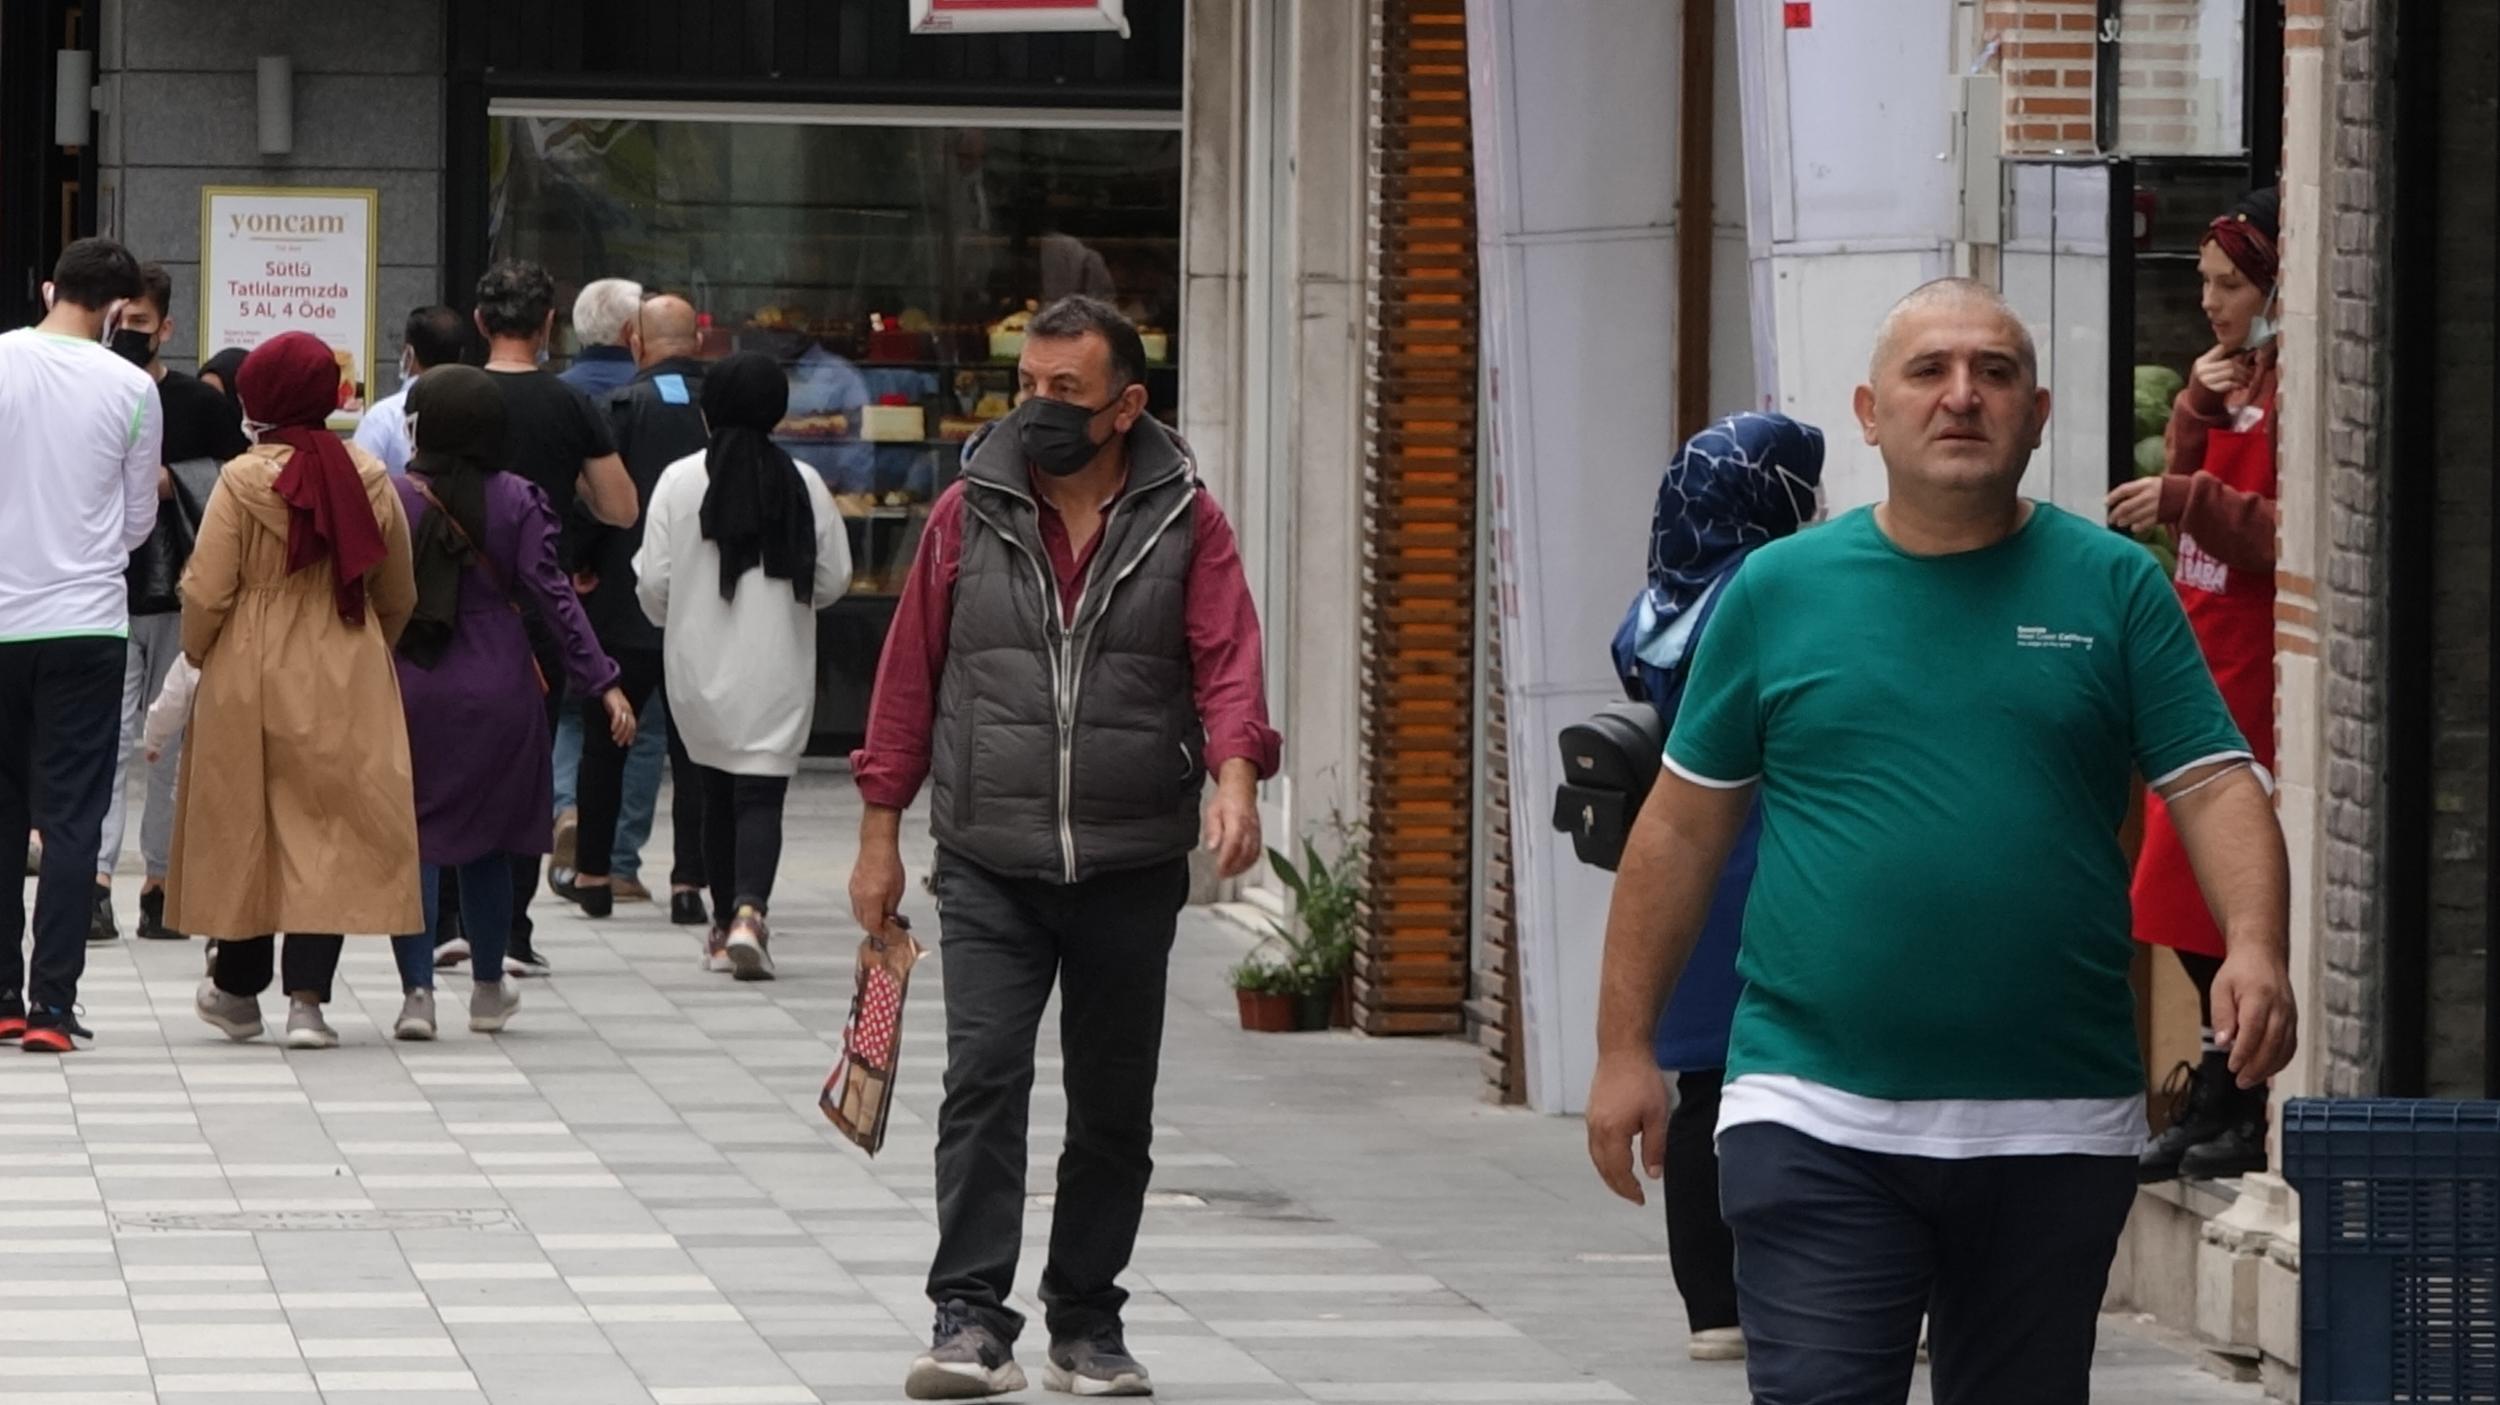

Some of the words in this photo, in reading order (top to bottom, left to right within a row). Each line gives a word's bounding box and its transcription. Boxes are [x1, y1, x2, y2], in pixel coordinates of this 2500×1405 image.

[229, 212, 344, 239] yoncam
[265, 260, 312, 278] Sütlü
[228, 281, 349, 299] Tatlılarımızda
[240, 302, 250, 317] 5
[254, 302, 276, 319] Al,
[283, 303, 293, 317] 4
[299, 300, 336, 319] Öde
